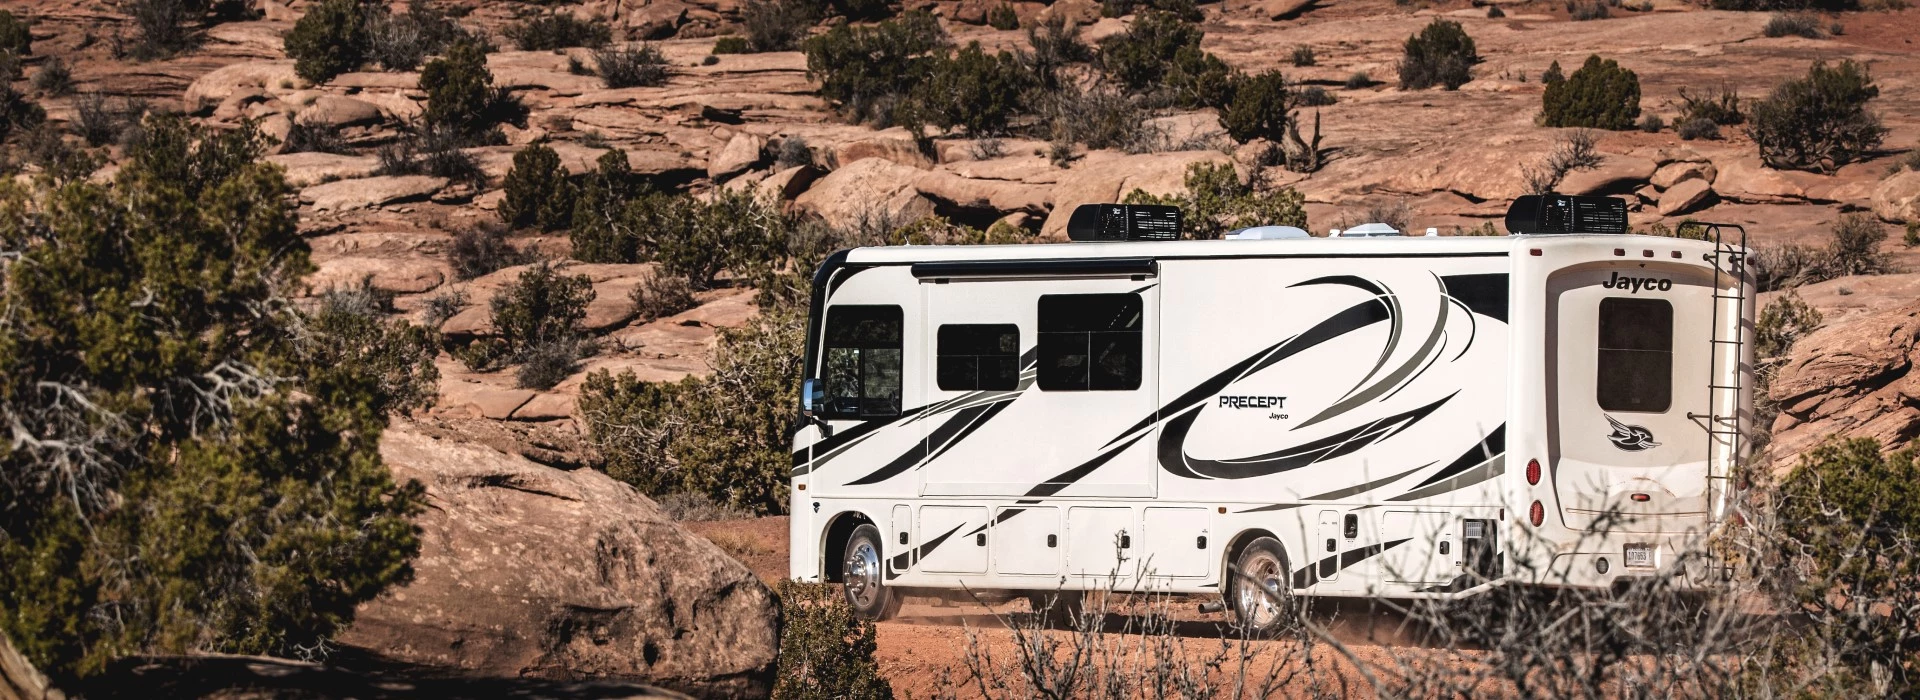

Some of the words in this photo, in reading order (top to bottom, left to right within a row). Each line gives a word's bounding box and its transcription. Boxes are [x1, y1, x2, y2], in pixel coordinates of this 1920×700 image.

[1602, 271, 1672, 294] Jayco
[1219, 395, 1287, 409] PRECEPT
[1268, 412, 1289, 420] Jayco
